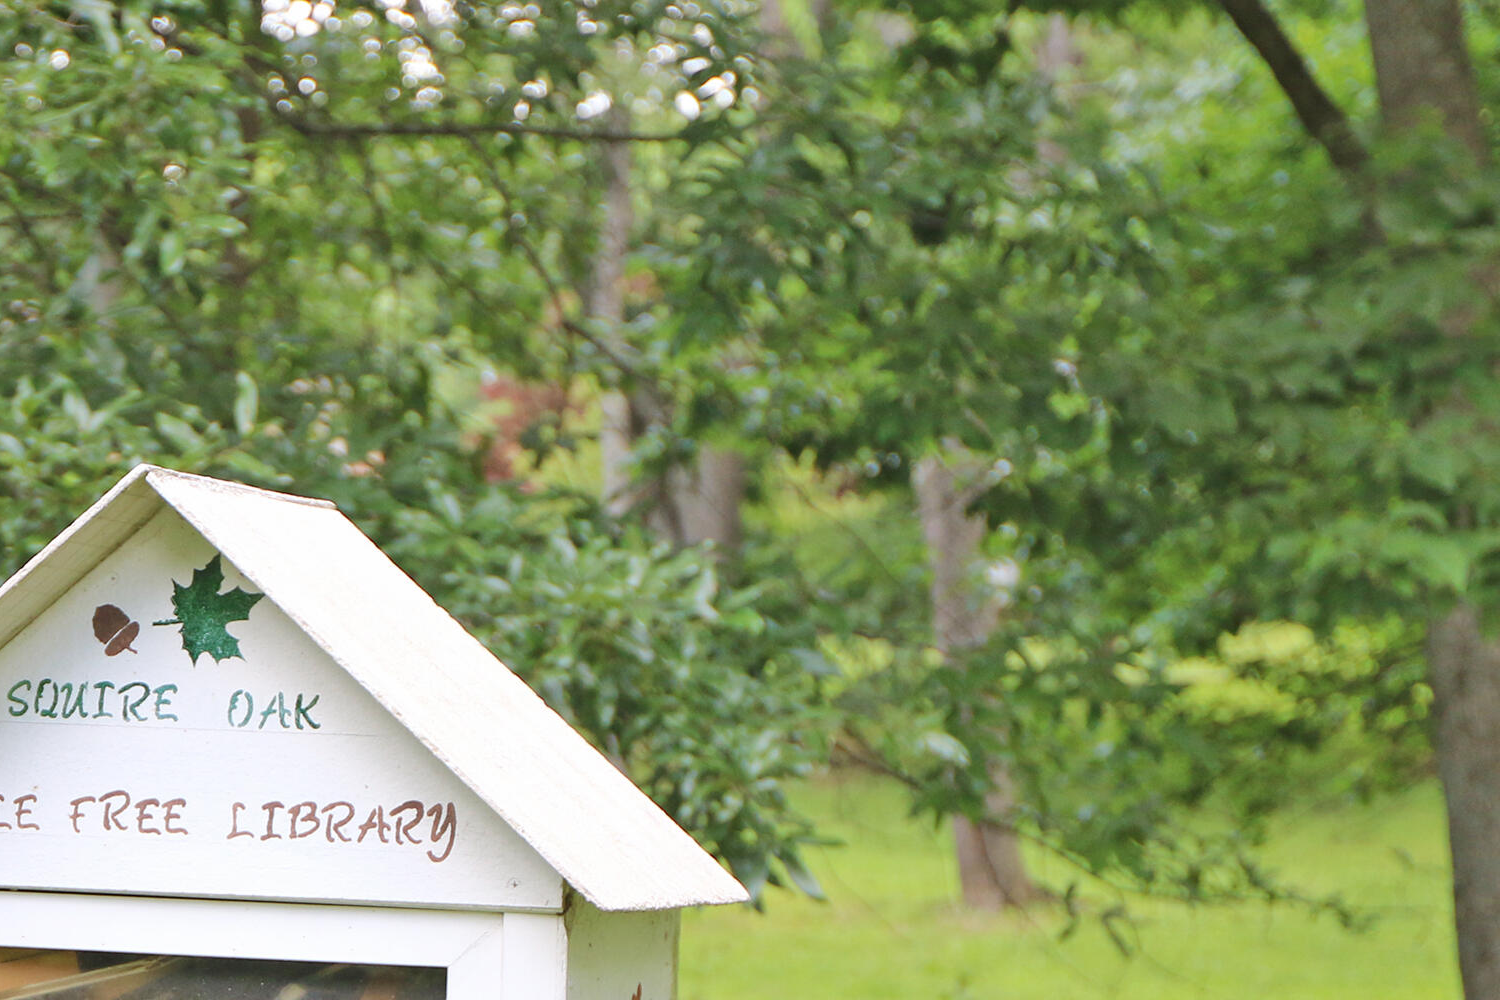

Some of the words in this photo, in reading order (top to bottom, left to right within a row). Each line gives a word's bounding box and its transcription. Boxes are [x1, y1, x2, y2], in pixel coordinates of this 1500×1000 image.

[8, 679, 180, 723] SQUIRE
[228, 690, 322, 730] OAK
[70, 790, 190, 837] FREE
[227, 800, 458, 864] LIBRARY
